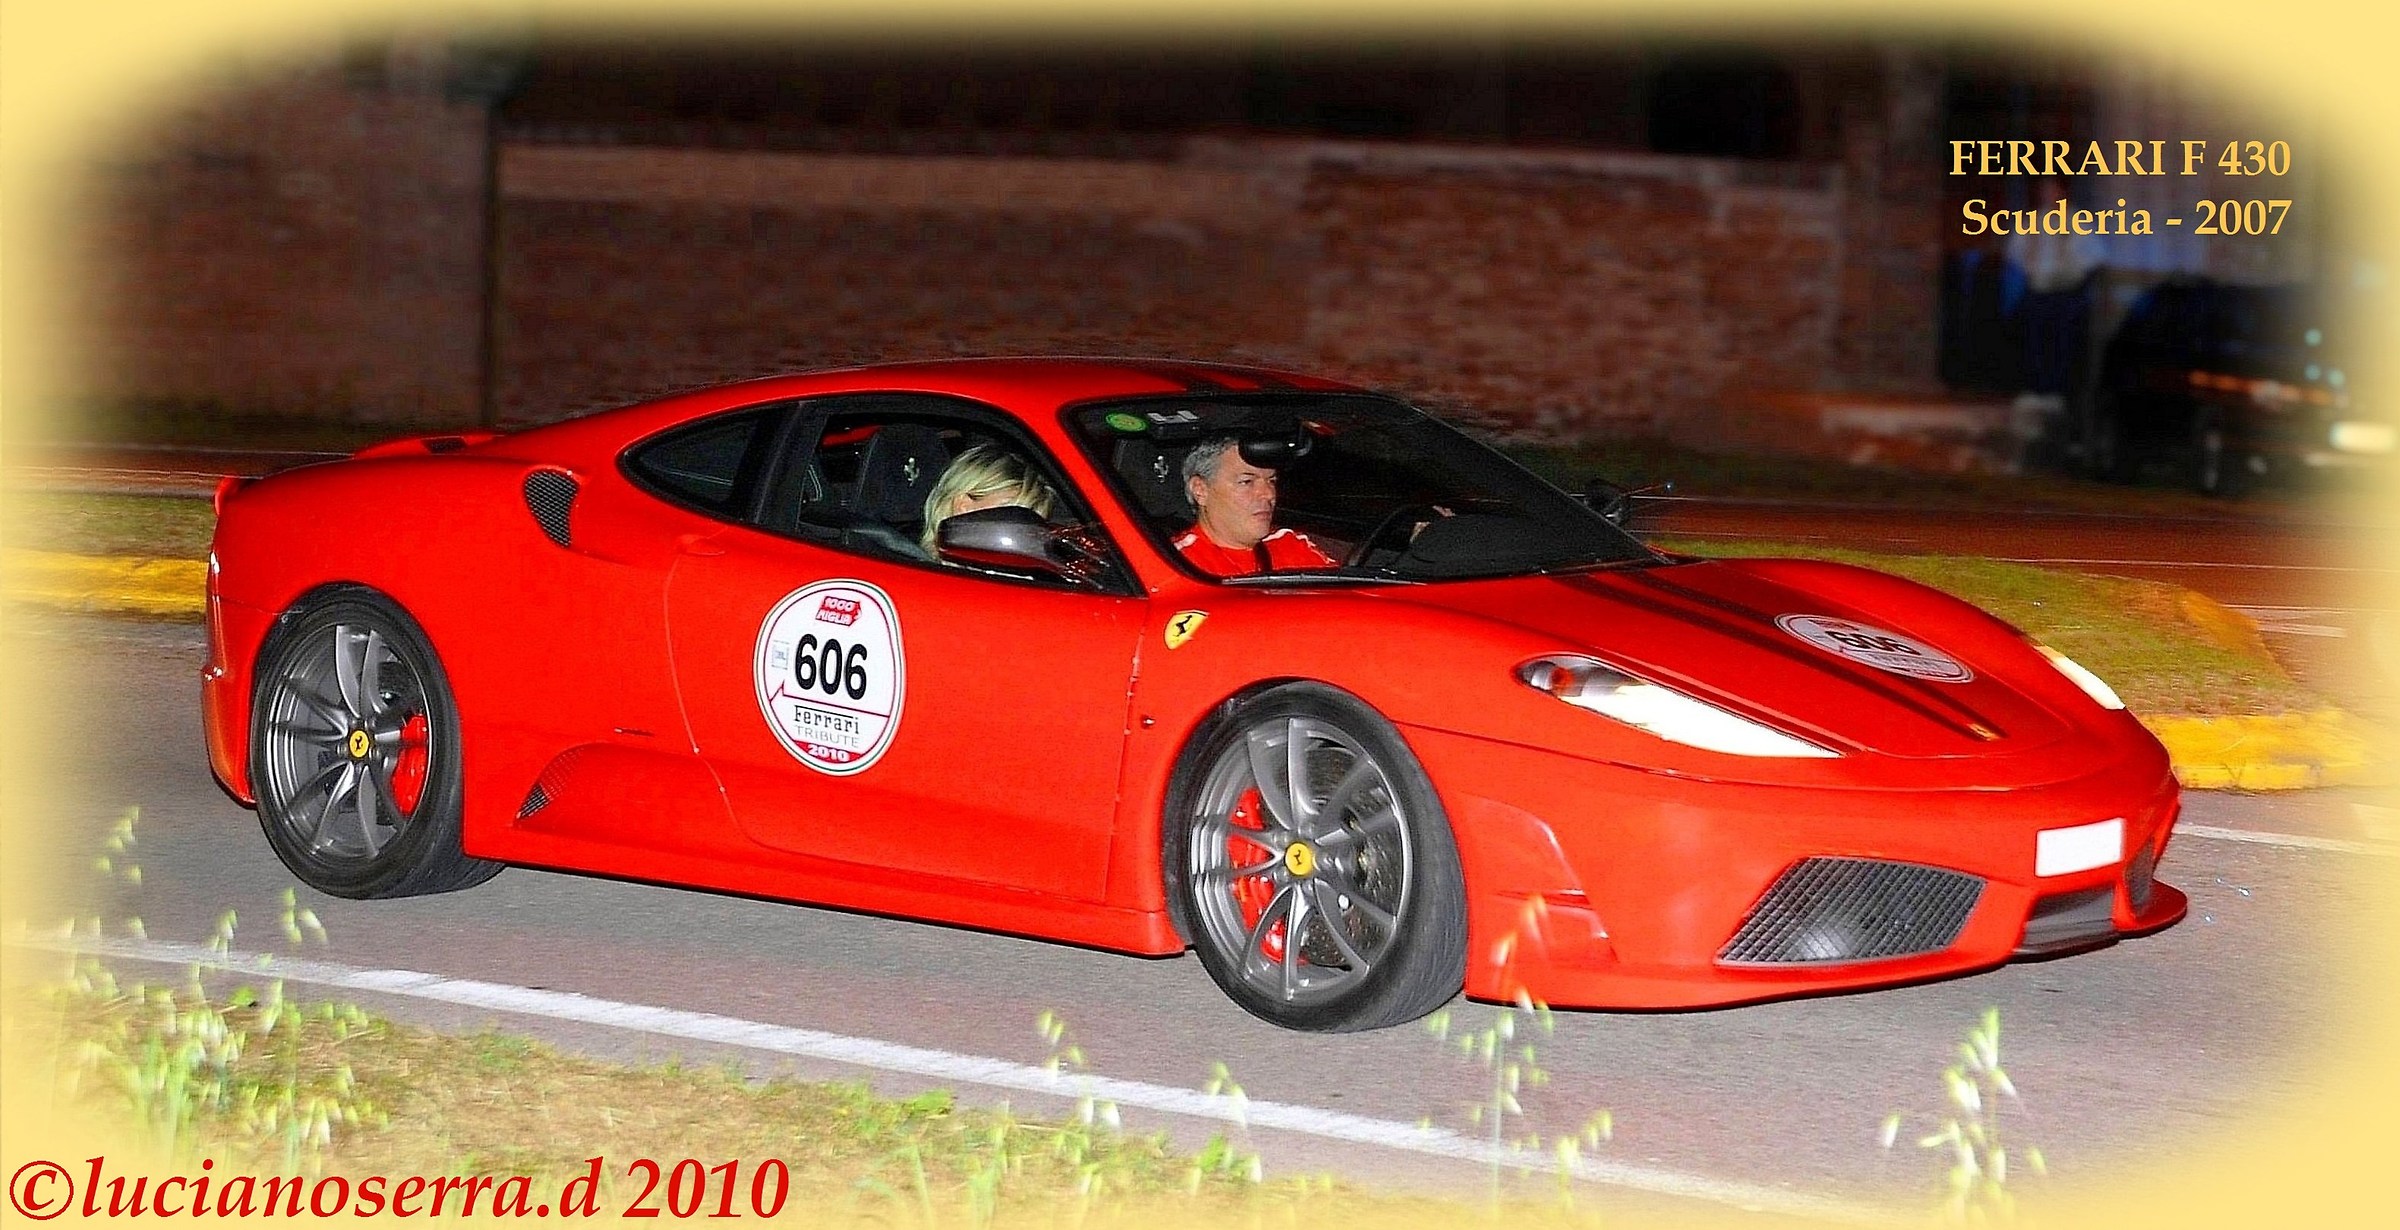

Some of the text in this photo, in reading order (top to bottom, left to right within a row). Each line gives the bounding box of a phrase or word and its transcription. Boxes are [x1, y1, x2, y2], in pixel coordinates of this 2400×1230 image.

[824, 597, 856, 612] 1000
[1825, 630, 1922, 656] 606
[794, 633, 868, 700] 606
[793, 704, 860, 735] Ferrari
[795, 725, 860, 749] TRIBUTE
[807, 744, 850, 762] 2010
